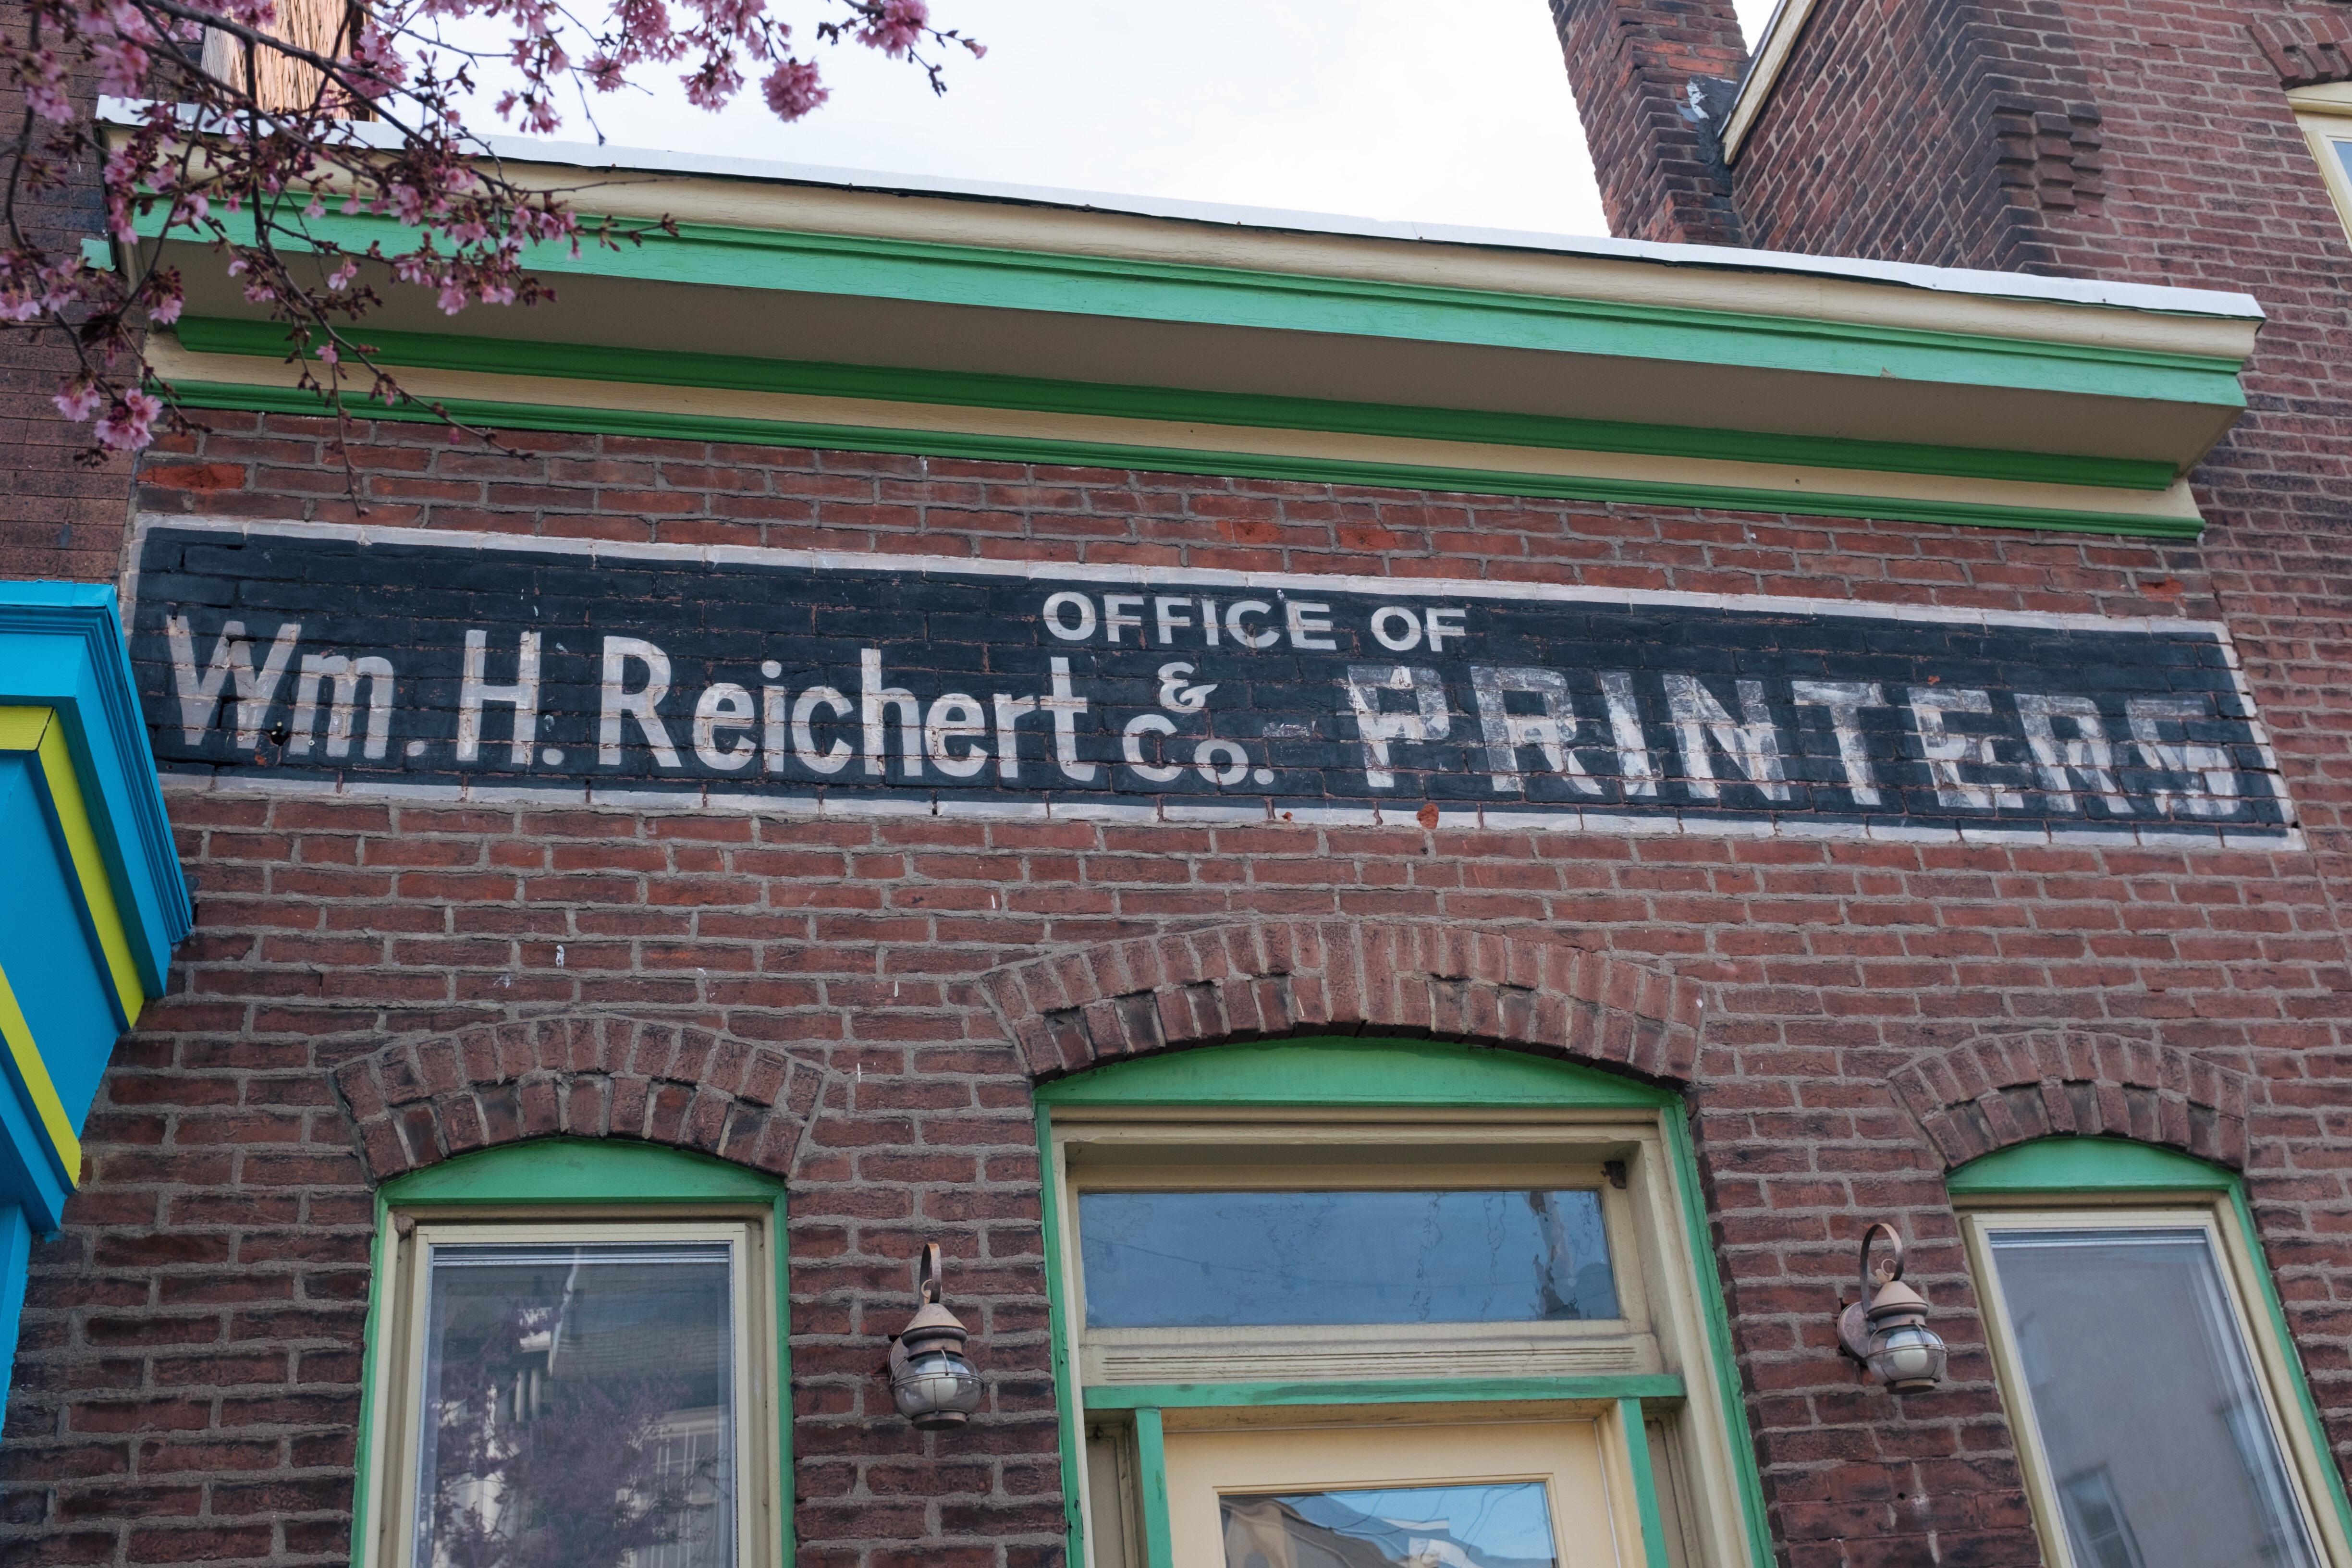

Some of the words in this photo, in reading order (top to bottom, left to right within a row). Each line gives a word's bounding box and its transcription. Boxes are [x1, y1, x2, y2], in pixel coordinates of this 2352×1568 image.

[166, 614, 427, 760] Wm.
[1043, 590, 1336, 651] OFFICE
[1370, 605, 1467, 652] OF
[1158, 661, 1218, 714] &
[456, 628, 565, 767] H.
[598, 635, 1097, 782] Reichert
[1122, 713, 1275, 786] Co.
[1345, 663, 2241, 816] PRINTERS
